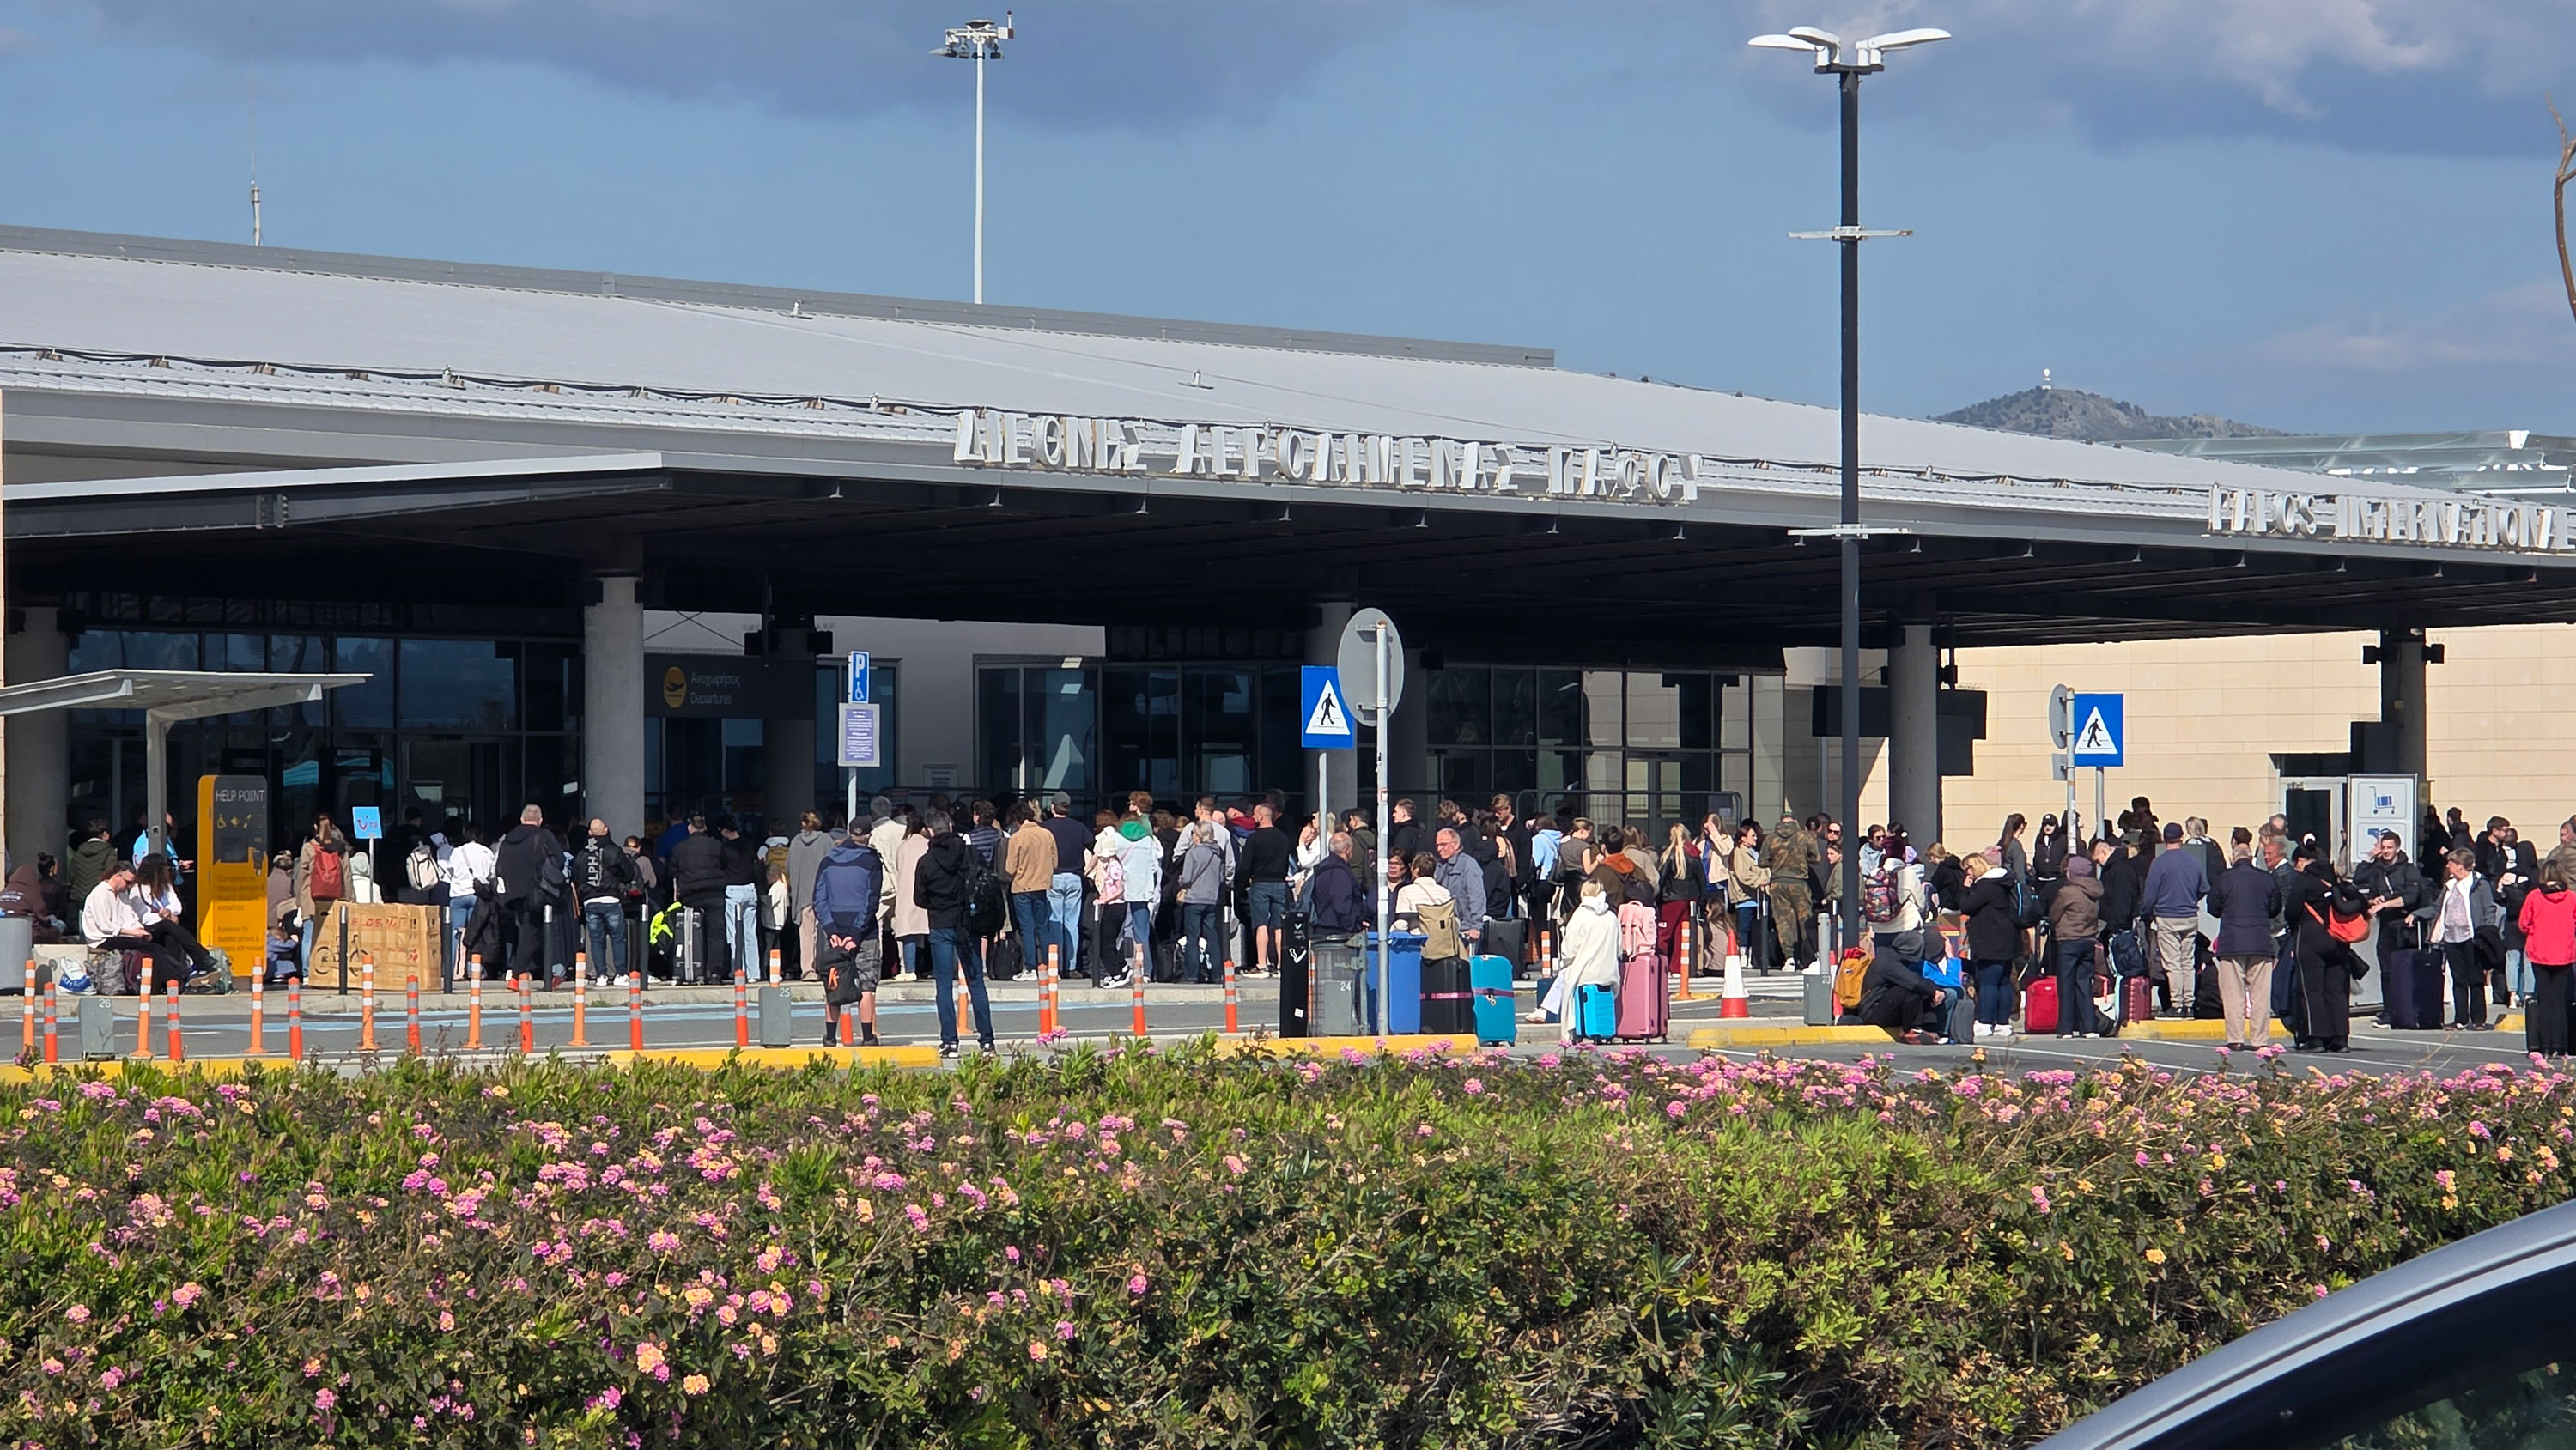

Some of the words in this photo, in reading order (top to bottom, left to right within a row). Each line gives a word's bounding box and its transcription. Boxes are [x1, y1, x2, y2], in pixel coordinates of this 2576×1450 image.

[855, 654, 866, 678] P
[690, 692, 733, 706] Departures
[216, 789, 237, 802] HELP
[239, 789, 265, 802] POINT
[1822, 975, 1831, 984] 23
[1340, 981, 1351, 991] 24
[779, 987, 790, 998] 25
[99, 998, 111, 1008] 26
